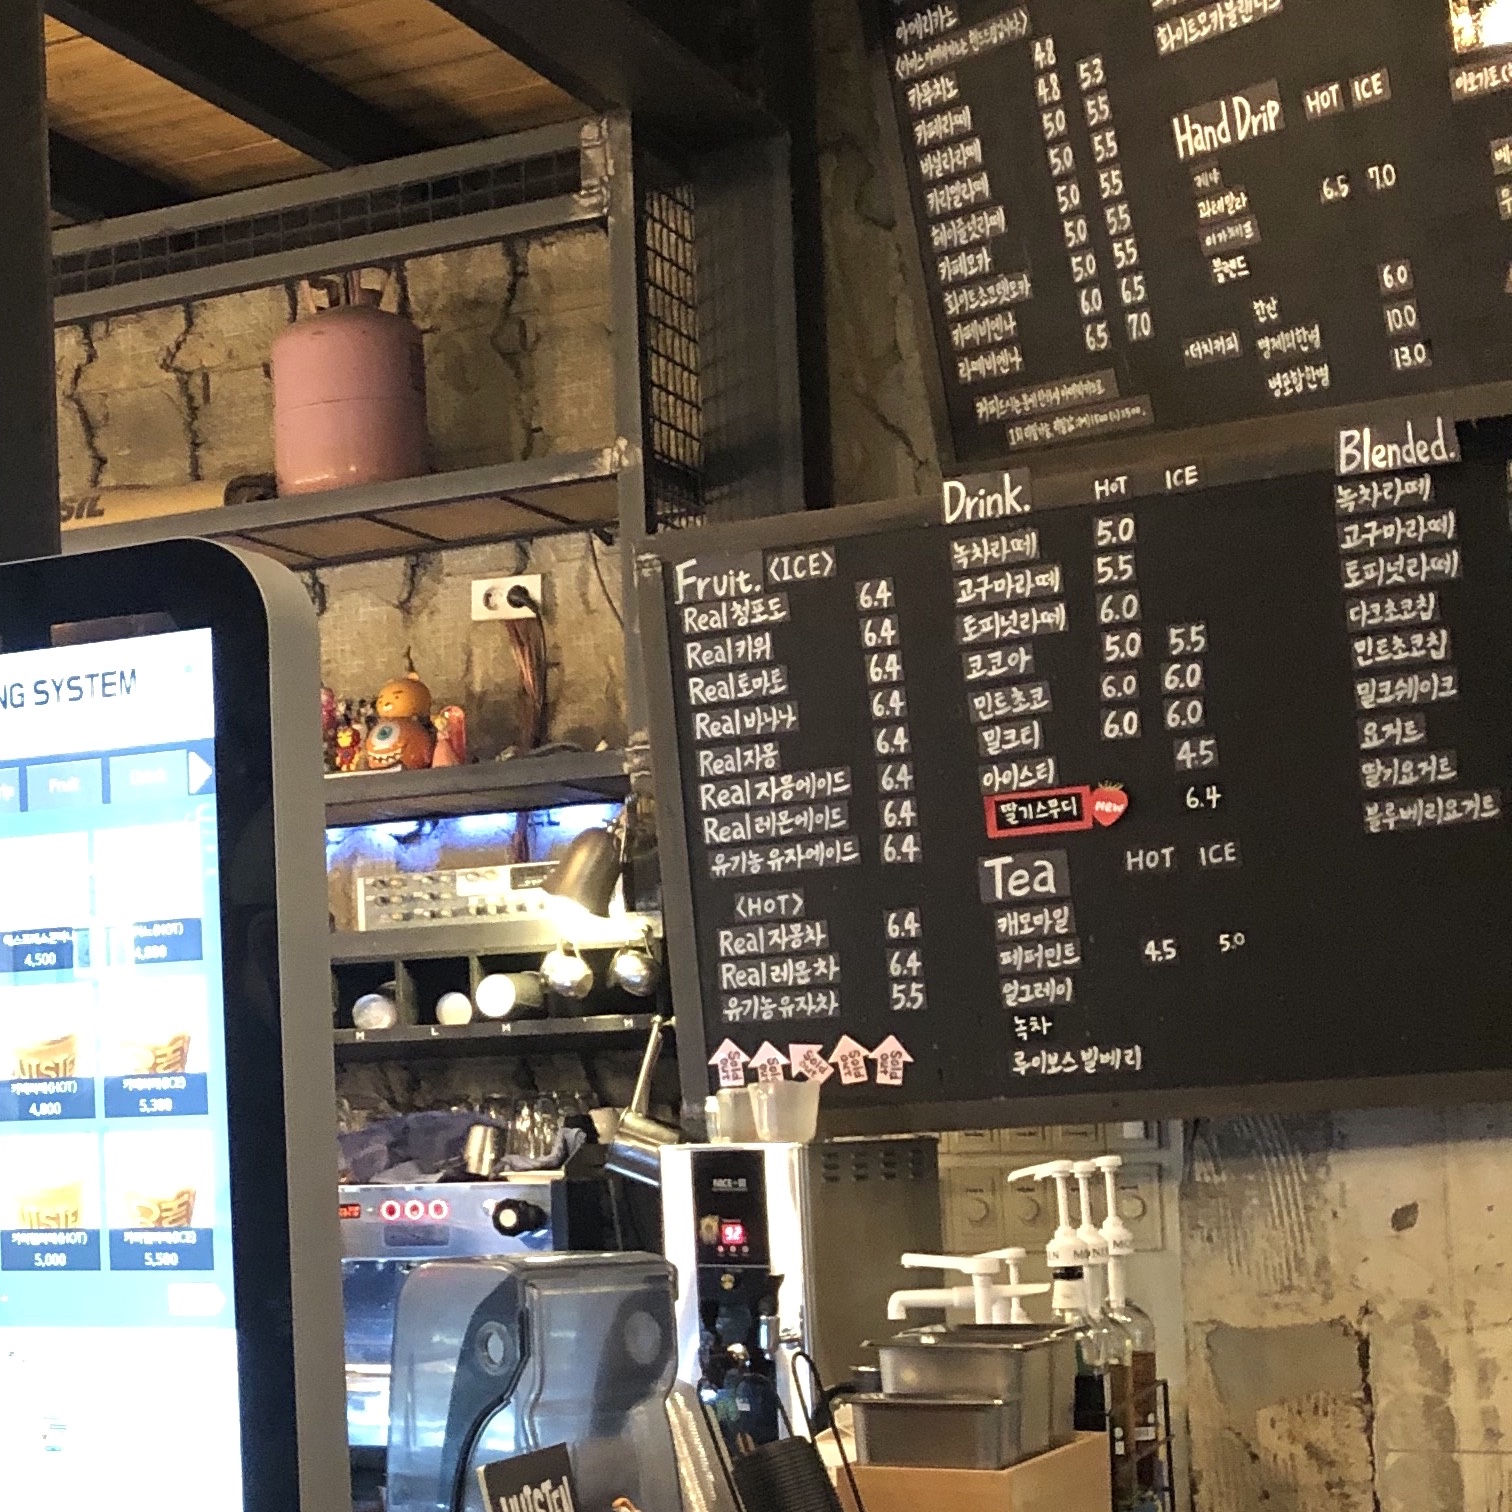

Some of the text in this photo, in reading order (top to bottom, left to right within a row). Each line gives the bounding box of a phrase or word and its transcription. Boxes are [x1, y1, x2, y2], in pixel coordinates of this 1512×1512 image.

[1034, 37, 1057, 68] 4.8
[1038, 72, 1061, 104] 4.8
[1079, 57, 1104, 90] 5.3
[1307, 73, 1384, 113] HOT ICE
[1042, 109, 1066, 140] 5.0
[1087, 94, 1110, 127] 5.5
[1173, 101, 1231, 160] Hand
[1050, 145, 1073, 176] 5.0
[1093, 130, 1118, 162] 5.5
[1099, 169, 1123, 199] 5.5
[1323, 164, 1396, 200] 6.5 7.0
[1056, 182, 1080, 213] 5.0
[1064, 218, 1087, 247] 5.0
[1105, 204, 1131, 235] 5.5
[1072, 253, 1096, 283] 5.0
[1113, 238, 1137, 269] 5.5
[1121, 275, 1146, 305] 6.5
[1383, 265, 1408, 288] 6.0
[1081, 288, 1103, 317] 6.0
[1127, 312, 1152, 342] 7.0
[1387, 305, 1417, 332] 10.0
[1085, 323, 1109, 351] 6.5
[1394, 343, 1427, 369] 13.0
[1165, 466, 1199, 489] ICE
[1337, 472, 1431, 513] 녹차라떼
[1097, 518, 1134, 546] 5.0
[1341, 510, 1455, 549] 고구마라떼
[953, 532, 1038, 569] 녹차라떼
[1097, 556, 1133, 584] 5.5
[1344, 550, 1459, 589] 토피넛라떼
[860, 580, 891, 608] 6.4
[956, 566, 1060, 605] 고구마라떼
[684, 602, 727, 632] Real
[962, 602, 1066, 643] 토피넛라떼
[1100, 594, 1138, 624] 6.0
[865, 618, 896, 646] 6.4
[1105, 624, 1206, 662] 5.0 5.5
[687, 639, 732, 669] Real
[870, 653, 901, 682] 6.4
[966, 647, 1033, 680] 코코아
[34, 668, 138, 707] SYSTEM
[689, 675, 734, 705] Real
[1102, 663, 1201, 699] 6.0 6.0
[873, 690, 905, 716] 6.4
[973, 686, 1049, 721] 민트초코
[695, 709, 740, 740] Real
[1103, 700, 1203, 739] 6.0 6.0
[1360, 717, 1425, 750] 요거트
[877, 726, 909, 754] 6.4
[982, 720, 1039, 756] 밀크티
[699, 747, 742, 777] Real
[1176, 739, 1216, 769] 4.5
[882, 764, 913, 791] 6.4
[983, 757, 1056, 791] 아이스티
[1362, 755, 1458, 788] 딸기요거트
[700, 779, 750, 810] Real
[1186, 785, 1222, 809] 6.4
[884, 800, 915, 827] 6.4
[1000, 796, 1078, 825] 딸기스무디
[1365, 793, 1500, 832] 블루베리요거트
[704, 813, 750, 844] Real
[884, 834, 919, 863] 6.4
[1126, 842, 1237, 871] HOT ICE
[984, 856, 1057, 900] Tea
[888, 911, 920, 938] 6.4
[997, 905, 1069, 936] 캐모마일
[719, 928, 764, 957] Real
[1145, 939, 1177, 962] 4.5
[722, 963, 767, 989] Real
[890, 950, 921, 976] 6.4
[892, 984, 924, 1010] 5.5
[1013, 1016, 1052, 1041] 녹차
